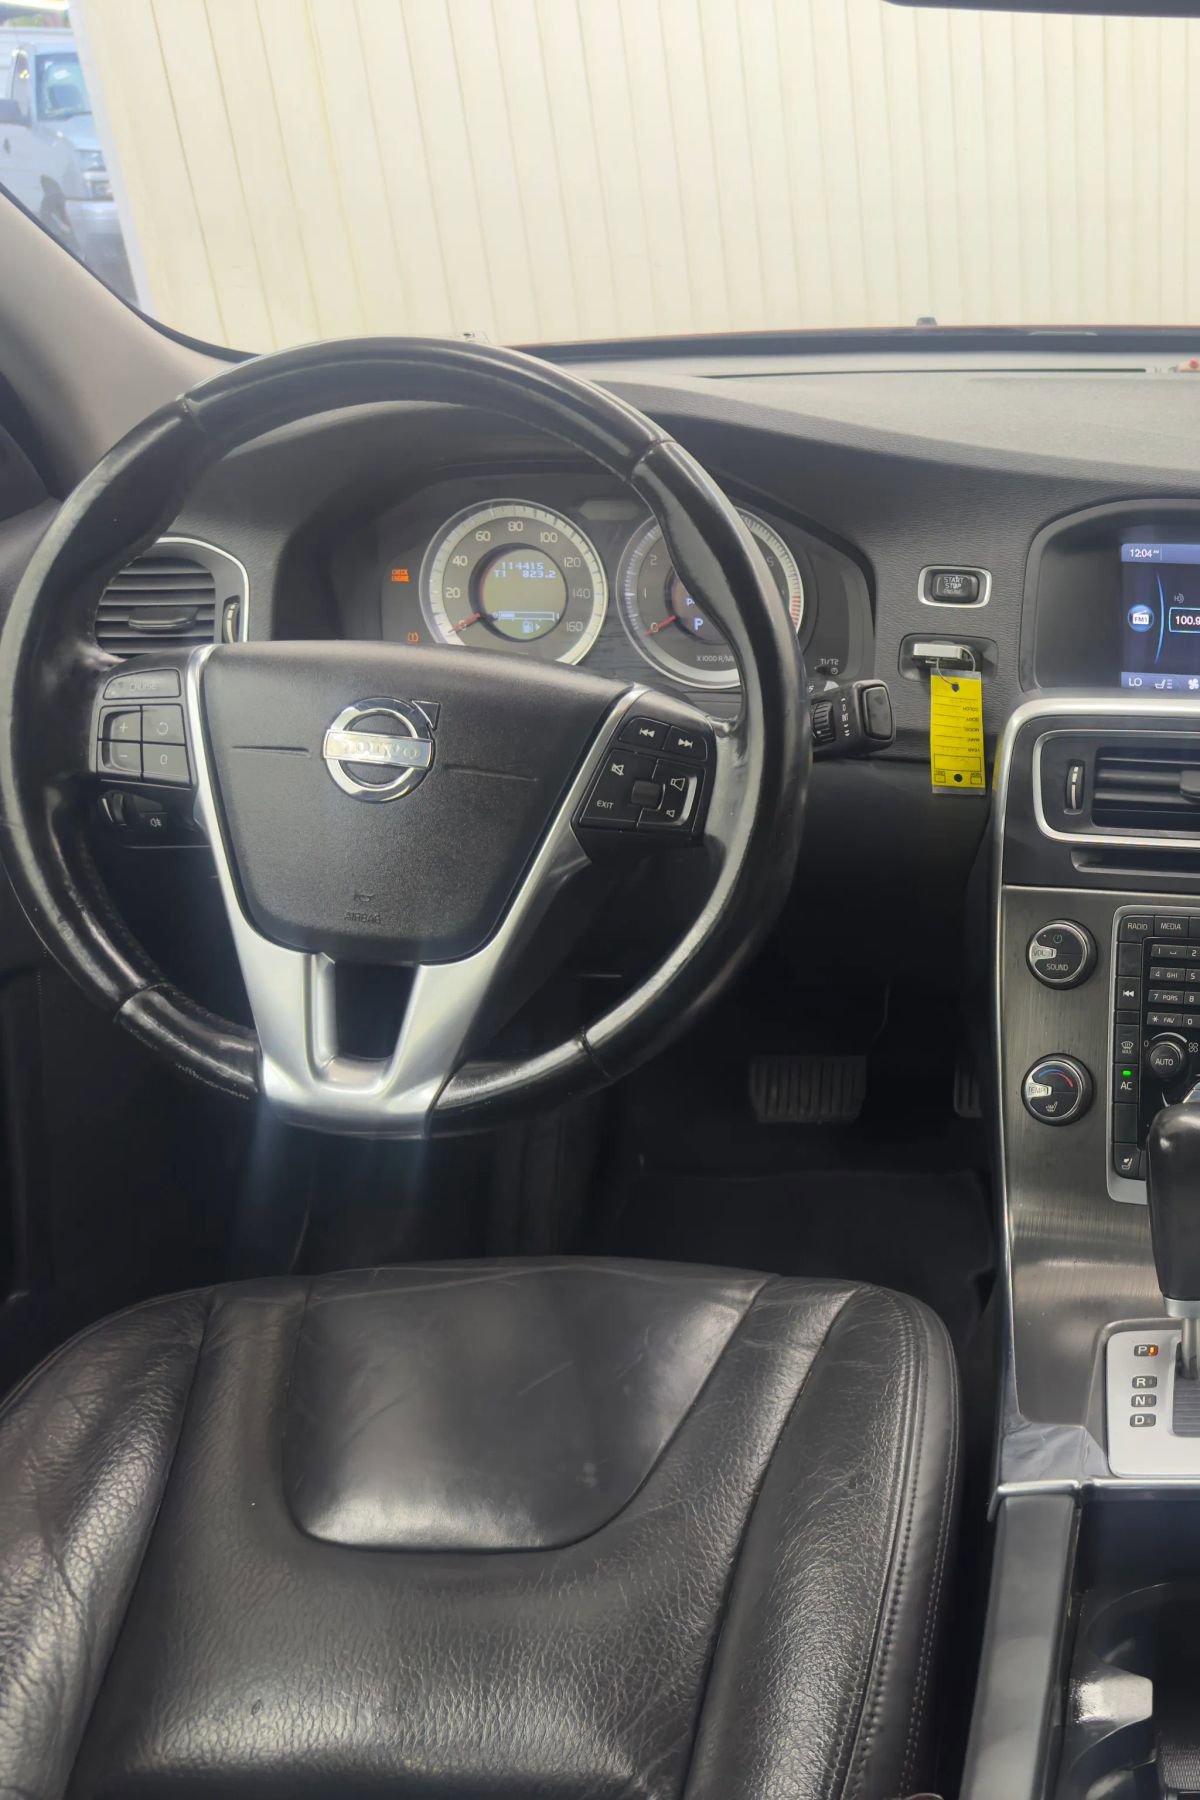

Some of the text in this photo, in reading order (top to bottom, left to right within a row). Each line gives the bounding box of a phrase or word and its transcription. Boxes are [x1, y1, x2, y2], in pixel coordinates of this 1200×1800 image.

[507, 520, 524, 532] 80
[475, 530, 491, 542] 60
[540, 531, 558, 543] 100
[1130, 548, 1152, 558] 12:04
[452, 555, 468, 567] 40
[563, 556, 581, 568] 120
[650, 555, 657, 566] 2
[522, 570, 556, 578] 823.2
[445, 586, 461, 599] 20
[573, 588, 591, 599] 140
[566, 621, 583, 632] 160
[694, 618, 704, 630] P
[1128, 678, 1142, 687] LO
[596, 800, 613, 809] EXIT
[1127, 922, 1148, 930] RADIO
[1160, 922, 1181, 930] MEDIA
[1046, 963, 1069, 972] SOUND
[1190, 972, 1196, 980] 5
[1144, 1040, 1150, 1048] 0
[1155, 1058, 1174, 1066] AUTO
[1120, 1081, 1133, 1090] AC
[1138, 1346, 1147, 1354] P
[1136, 1378, 1146, 1387] R
[1135, 1396, 1146, 1405] N
[1134, 1416, 1145, 1425] D
